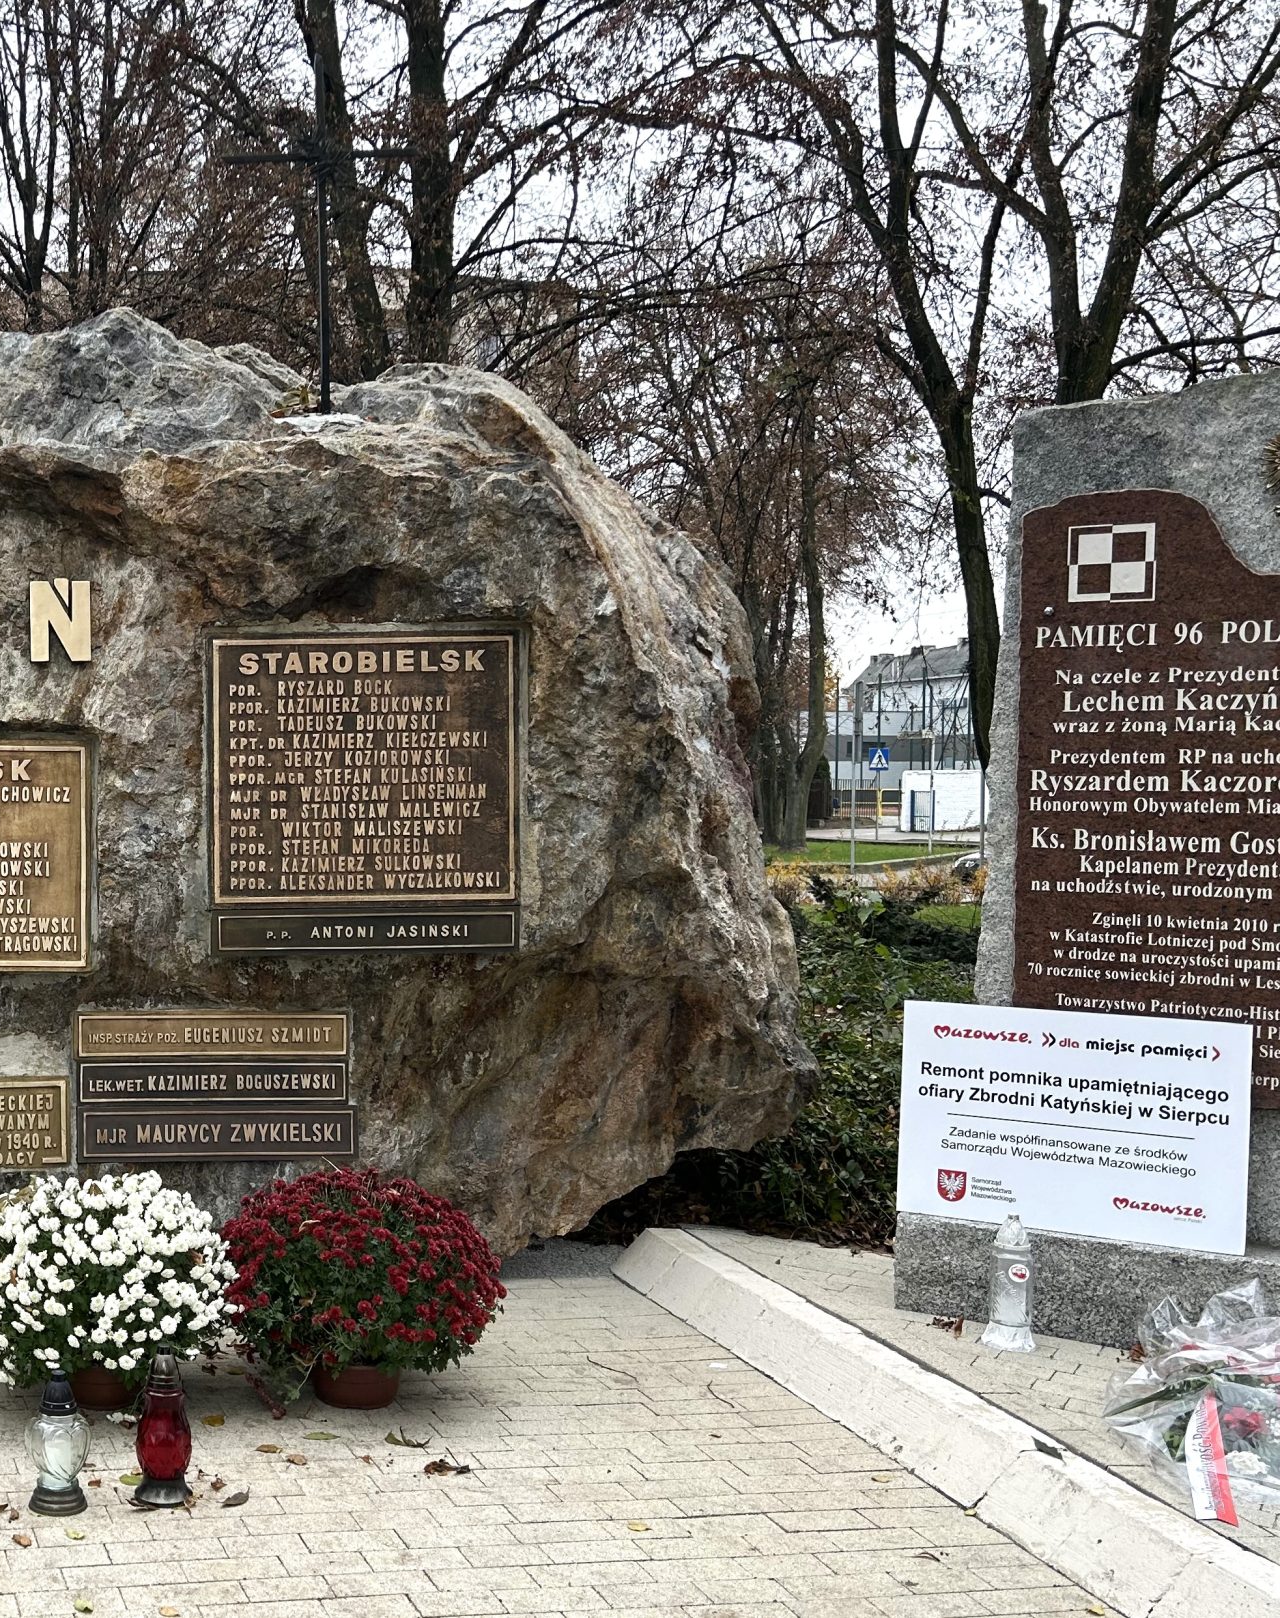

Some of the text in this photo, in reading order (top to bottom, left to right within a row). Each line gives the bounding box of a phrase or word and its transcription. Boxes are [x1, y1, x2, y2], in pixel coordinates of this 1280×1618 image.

[1035, 622, 1203, 652] PAMIĘCI 96
[239, 649, 485, 675] STAROBIELSK
[1055, 669, 1142, 684] Na czele
[229, 684, 261, 696] POR.
[278, 680, 344, 696] RYSZARD
[229, 696, 450, 714] PPOR. KAZIMIERZ BUKOWSKI
[1062, 690, 1164, 712] Lechem
[229, 715, 435, 732] POR. TADEUSZ BUKOWSKI
[1053, 717, 1236, 735] wraz żoną Marią
[293, 731, 487, 749] KAZIMIERZ KIEŁCZEWSKI
[230, 750, 449, 767] PPOR. JERZY KOZIOROWSKI
[1050, 749, 1233, 768] Prezydentem RP na
[315, 765, 471, 785] STEFAN KULASIŃSKI
[1030, 770, 1169, 796] Ryszardem
[230, 784, 486, 803] MJR DR WŁADYSŁAW LINSENMAN
[230, 802, 480, 820] MJR DR STANISŁAW MALEWICZ
[1029, 797, 1240, 816] Honorowym Obywatelem
[230, 820, 462, 837] POR. WIKTOR MALISZEWSKI
[230, 839, 429, 855] PPOR. STEFAN MIKORĘDA
[1031, 827, 1220, 853] Ks. Bronisławem
[230, 854, 461, 873] PPOR. KAZIMIERZ SULKOWSKI
[1080, 855, 1179, 877] Kapelanem
[230, 872, 500, 890] PPOR. ALEKSANDER WYCZAŁKOWSKI
[1031, 880, 1272, 903] na urodzonym
[310, 924, 468, 939] ANTONI JASIŃSKI
[1092, 912, 1268, 932] Zginęli 10 kwietnia 2010
[1065, 929, 1246, 952] Katastrofie Lotniczej pod
[1069, 947, 1229, 968] drodze na uroczystości
[1028, 963, 1234, 987] 70 rocznicę sowieckiej zbrodni
[1055, 993, 1145, 1012] Towarzystwo
[184, 1027, 332, 1043] EUGENIUSZ SZMIDT
[1059, 1037, 1079, 1048] dla
[1086, 1038, 1135, 1055] miejsc
[1141, 1044, 1207, 1060] pamięci
[148, 1073, 336, 1091] KAZIMIERZ BOGUSZEWSKI
[921, 1062, 1229, 1104] Remont pomnika upamiętniającego
[919, 1084, 1229, 1126] ofiary Zbrodni Katyńskiej w Sierpcu
[7, 1134, 39, 1149] 1940
[97, 1123, 341, 1144] MJR MAURYCY ZWYKIELSKI
[949, 1126, 1188, 1161] Zadanie współfinansowane ze środków
[941, 1139, 1196, 1178] Samorządu Województwa Mazowieckiego
